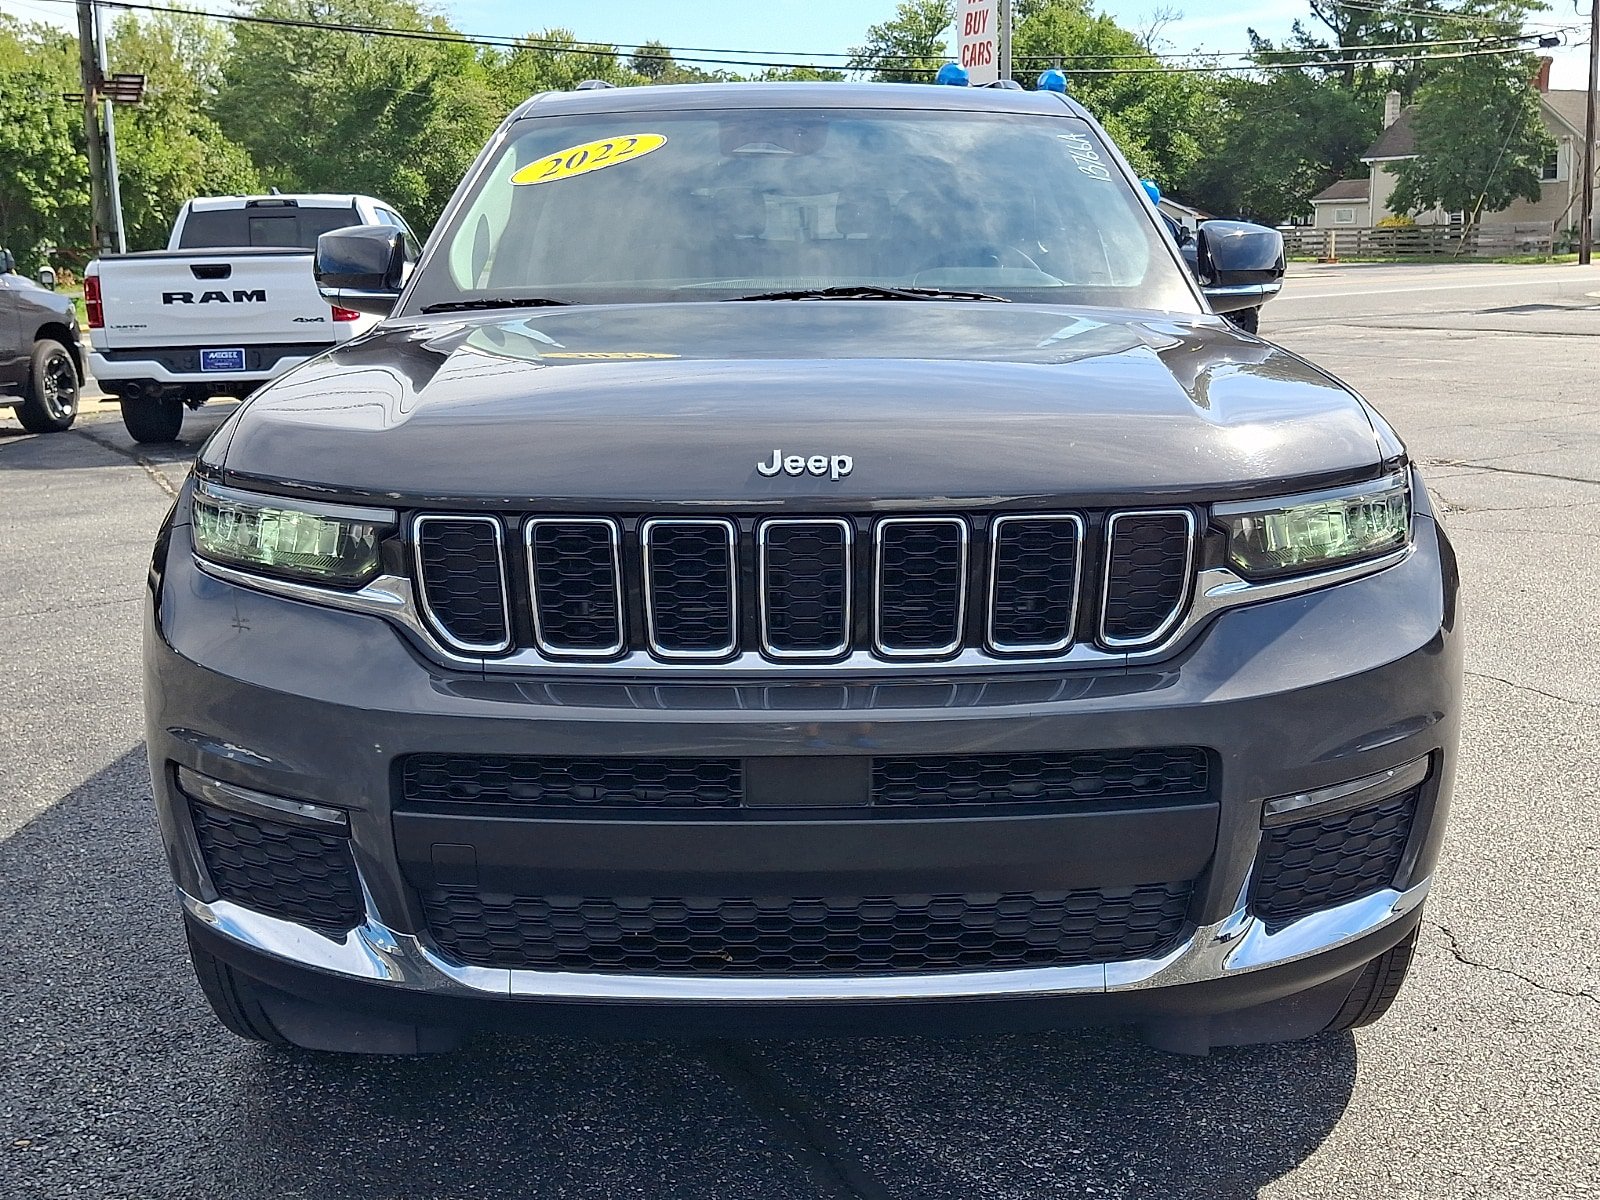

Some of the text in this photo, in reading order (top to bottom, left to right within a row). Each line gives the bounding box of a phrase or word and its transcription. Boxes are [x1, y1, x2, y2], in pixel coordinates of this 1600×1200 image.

[964, 9, 989, 36] BUY
[962, 41, 992, 67] CARS
[538, 138, 637, 178] 2022
[162, 290, 267, 305] RAM
[757, 449, 853, 482] Jeep
